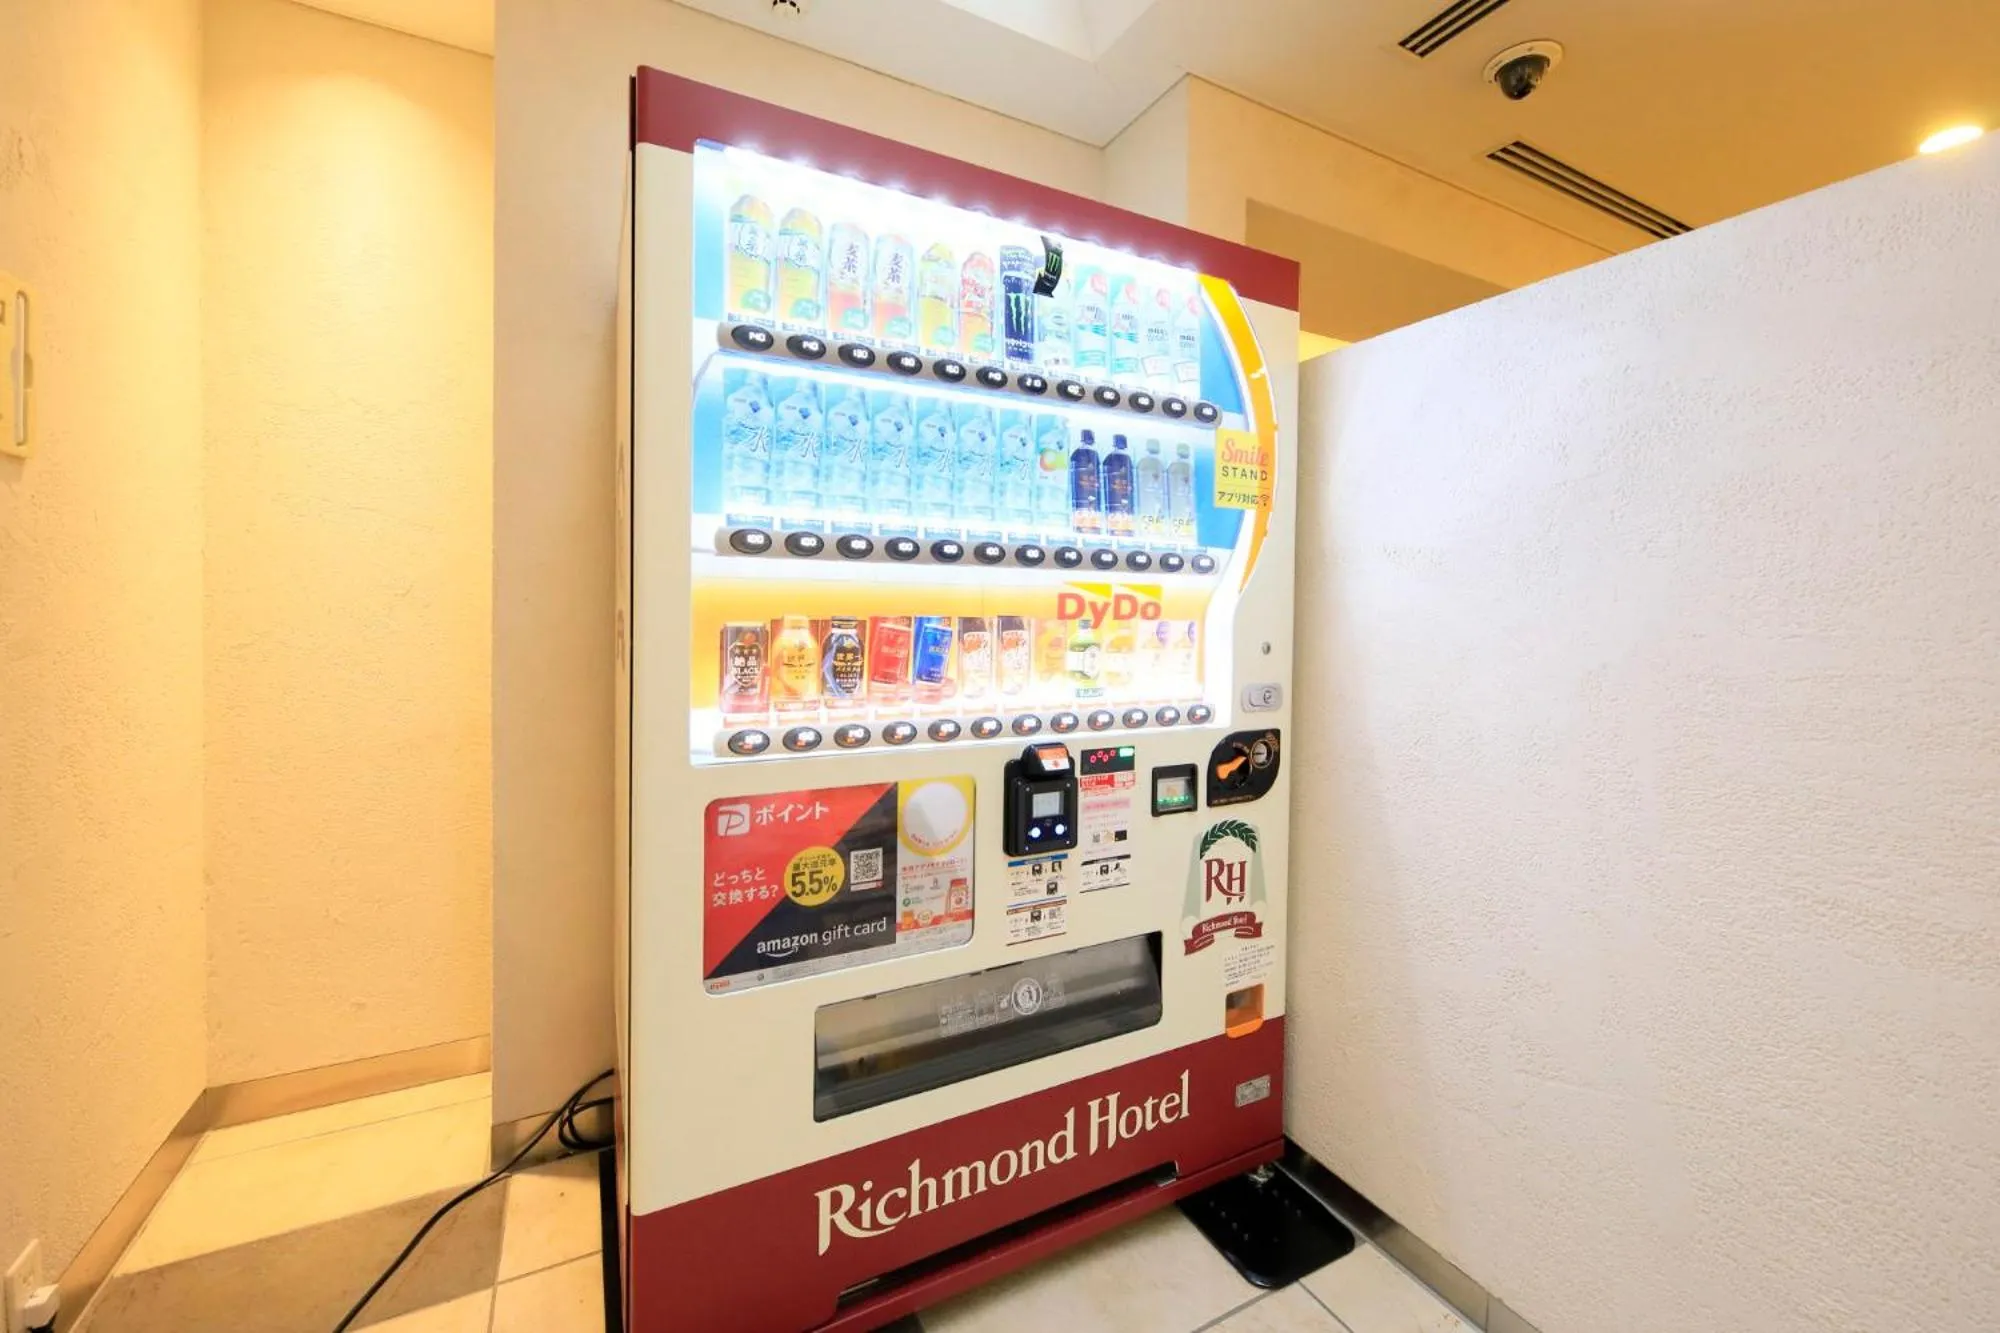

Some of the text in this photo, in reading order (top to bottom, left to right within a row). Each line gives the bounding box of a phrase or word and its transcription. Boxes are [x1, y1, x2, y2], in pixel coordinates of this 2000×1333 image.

[1222, 438, 1269, 466] Smile
[1222, 466, 1268, 481] STAND
[1056, 592, 1162, 630] DyDo
[755, 801, 829, 826] ポイント
[713, 867, 766, 887] どっちと
[791, 869, 837, 897] 5.5%
[1205, 858, 1247, 905] RH
[756, 917, 887, 958] amazon gift card
[814, 1069, 1191, 1256] Richmond Hotel
